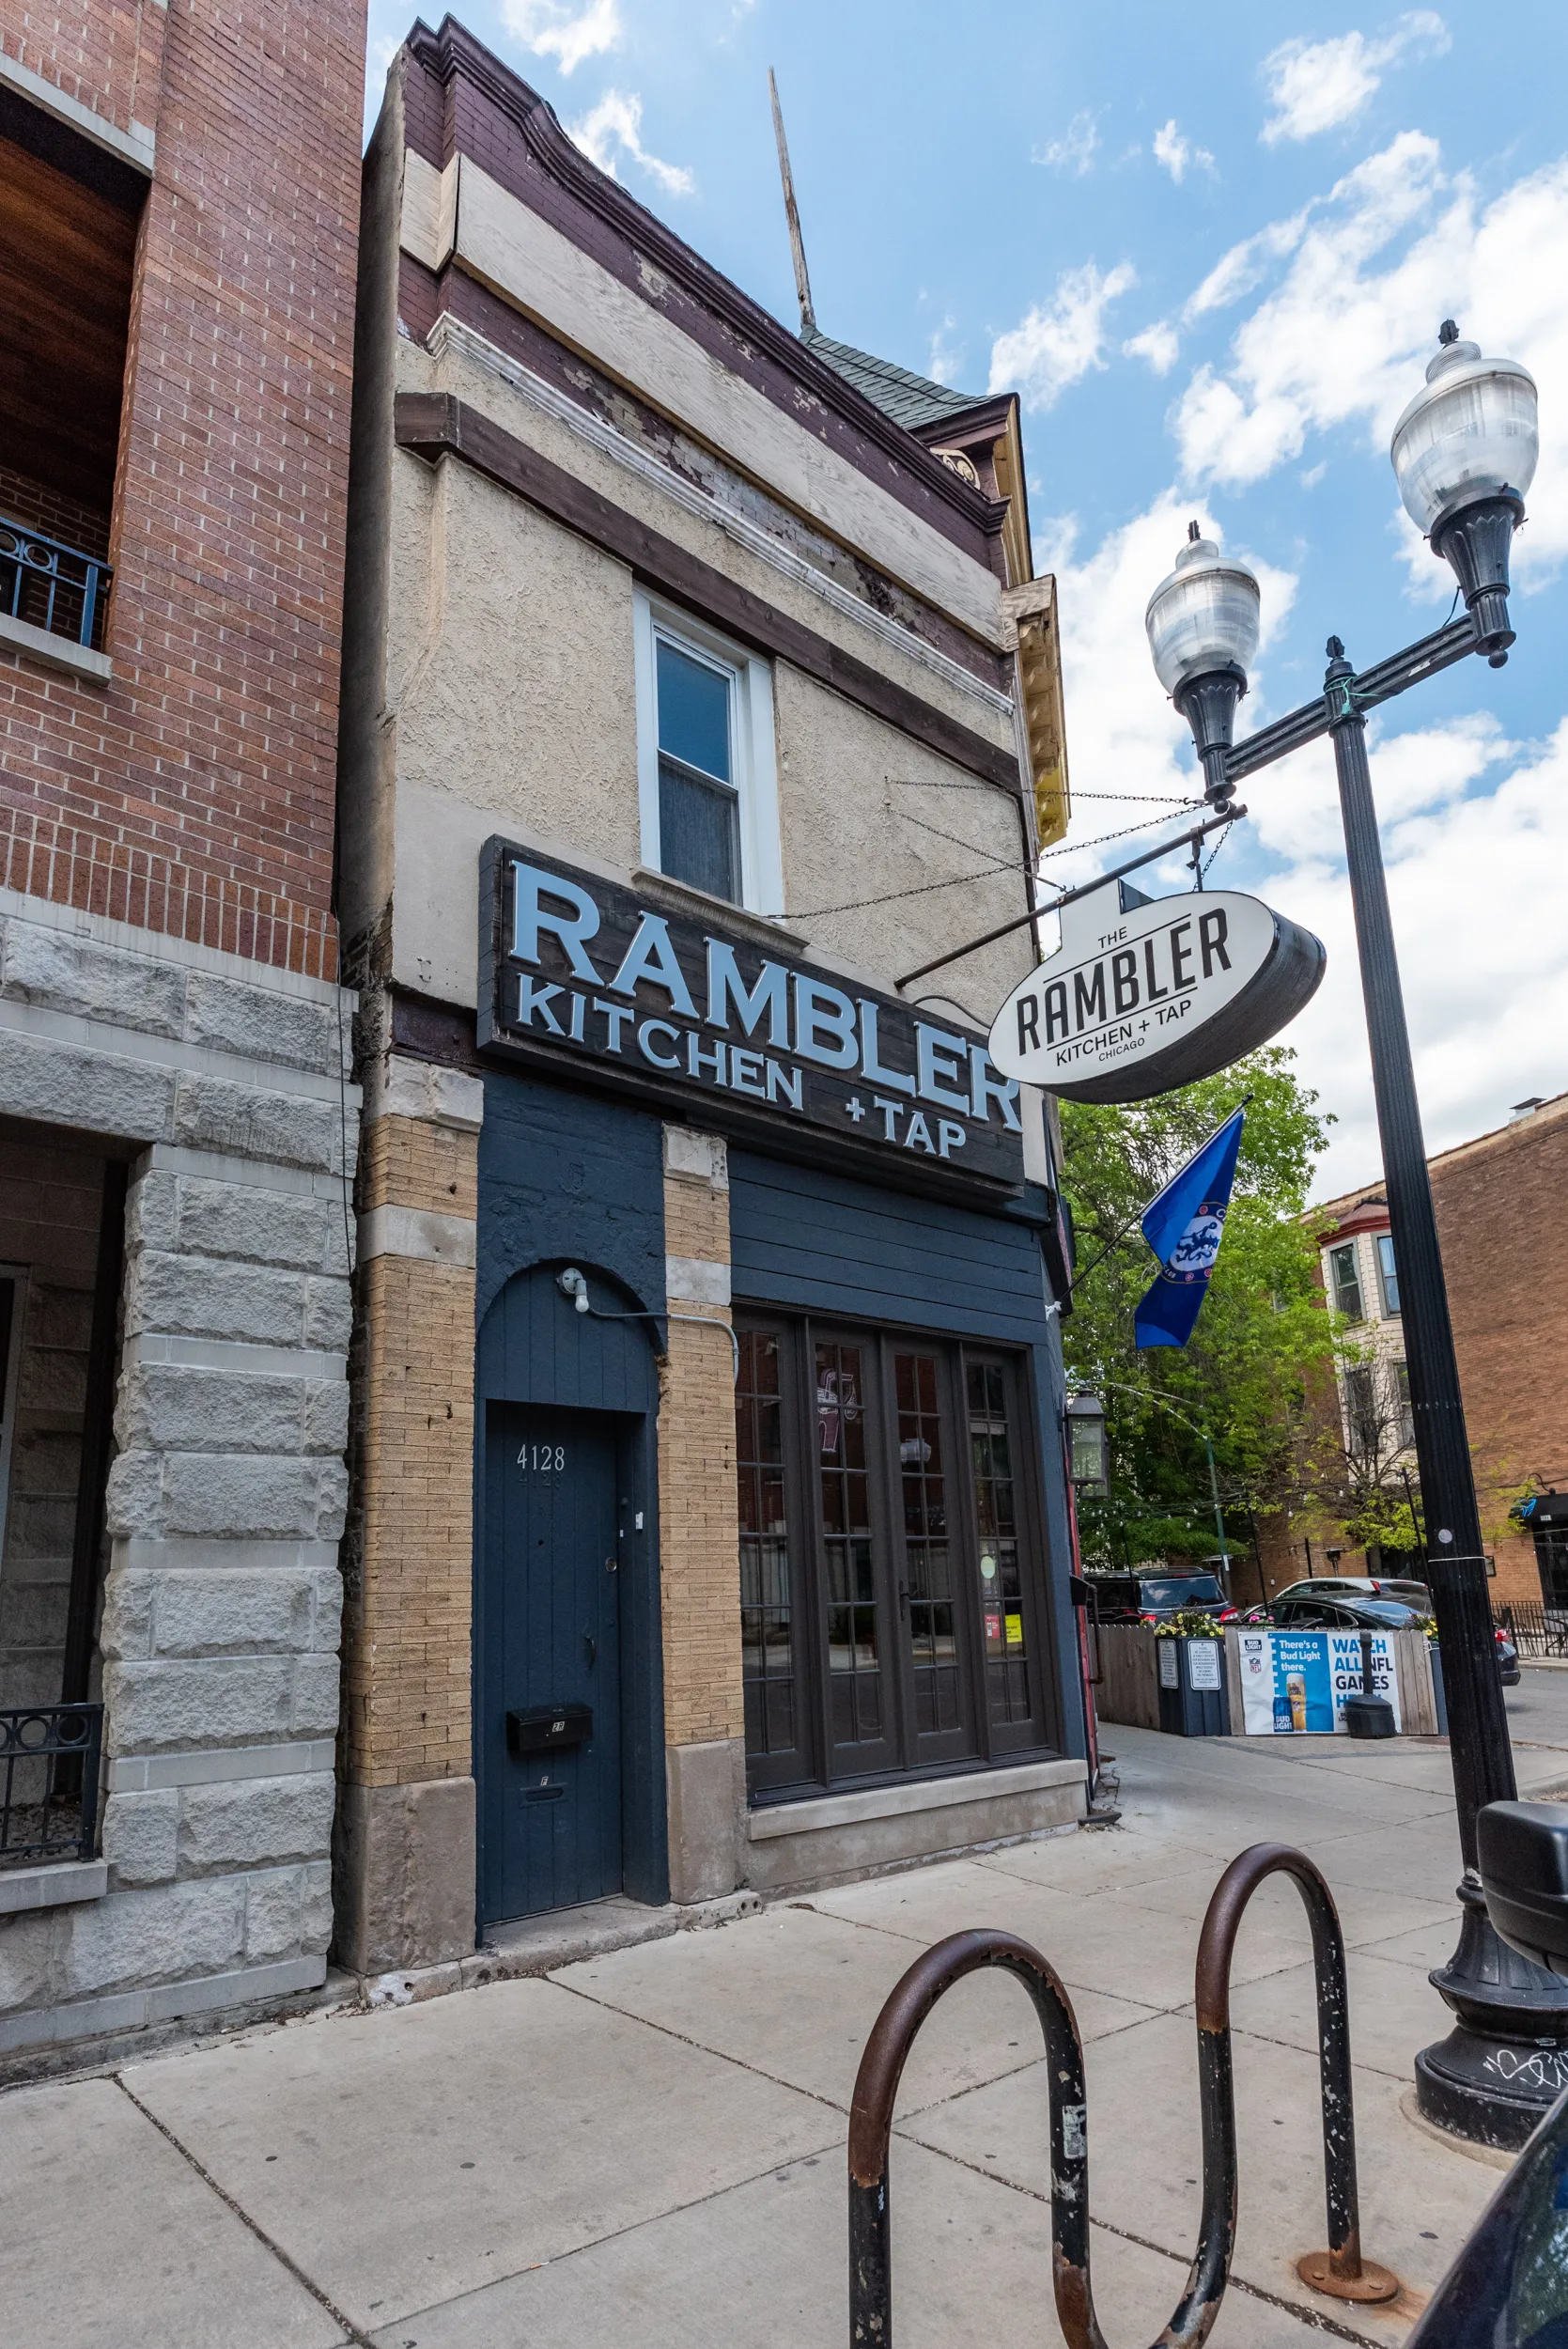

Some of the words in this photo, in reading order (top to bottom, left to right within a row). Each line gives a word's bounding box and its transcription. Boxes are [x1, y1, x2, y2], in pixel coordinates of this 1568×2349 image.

[1097, 926, 1128, 950] THE
[1017, 908, 1233, 1056] RAMBLER
[508, 859, 1022, 1133] RAMBLER
[516, 972, 804, 1112] KITCHEN
[1056, 1021, 1133, 1066] KITCHEN
[1138, 1019, 1151, 1034] +
[1155, 999, 1192, 1027] TAP
[1098, 1037, 1145, 1062] CHICAGO
[517, 1443, 565, 1471] 4128
[1279, 1640, 1311, 1649] There's
[1280, 1651, 1298, 1660] Bud
[1299, 1651, 1321, 1661] Light
[1281, 1662, 1307, 1672] there.
[1334, 1657, 1363, 1672] ALL
[553, 1721, 565, 1732] 2R
[1275, 1715, 1291, 1723] BUD
